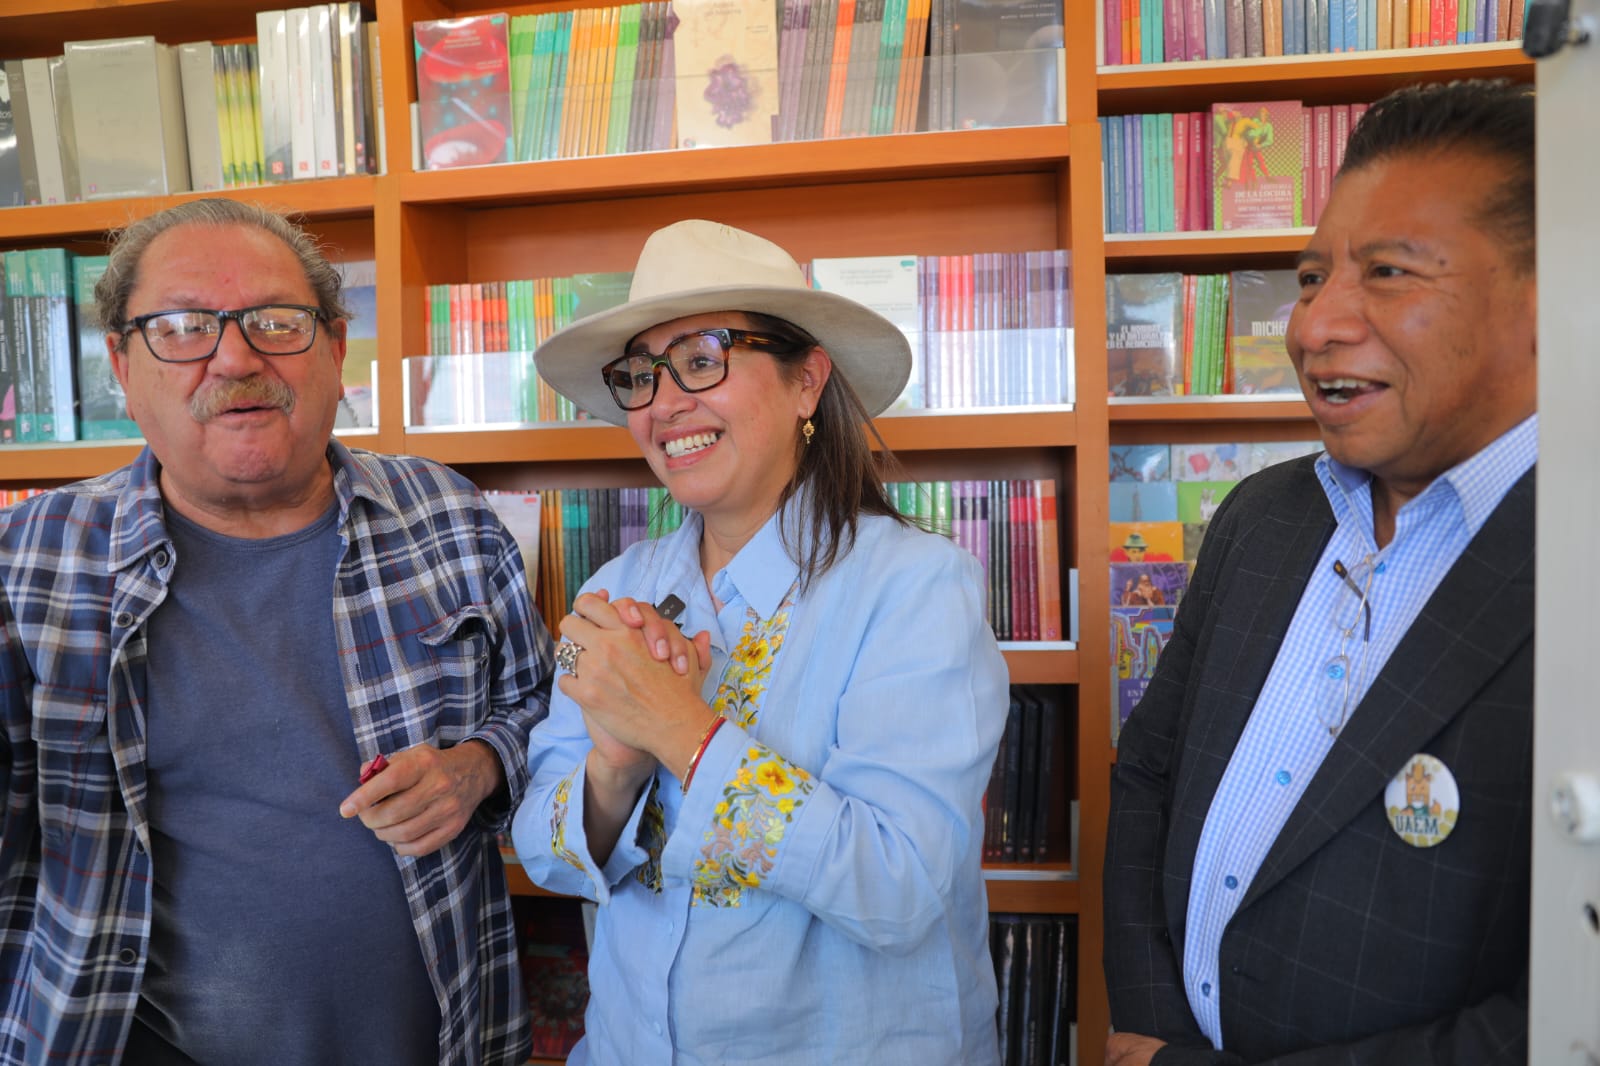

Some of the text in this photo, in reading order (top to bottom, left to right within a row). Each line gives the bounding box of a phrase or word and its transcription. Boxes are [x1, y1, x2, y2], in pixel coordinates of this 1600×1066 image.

[1252, 321, 1287, 337] MICHE
[1127, 332, 1173, 341] NATURALE
[1124, 340, 1176, 349] RENACIMIEN
[1395, 815, 1439, 835] UAEM
